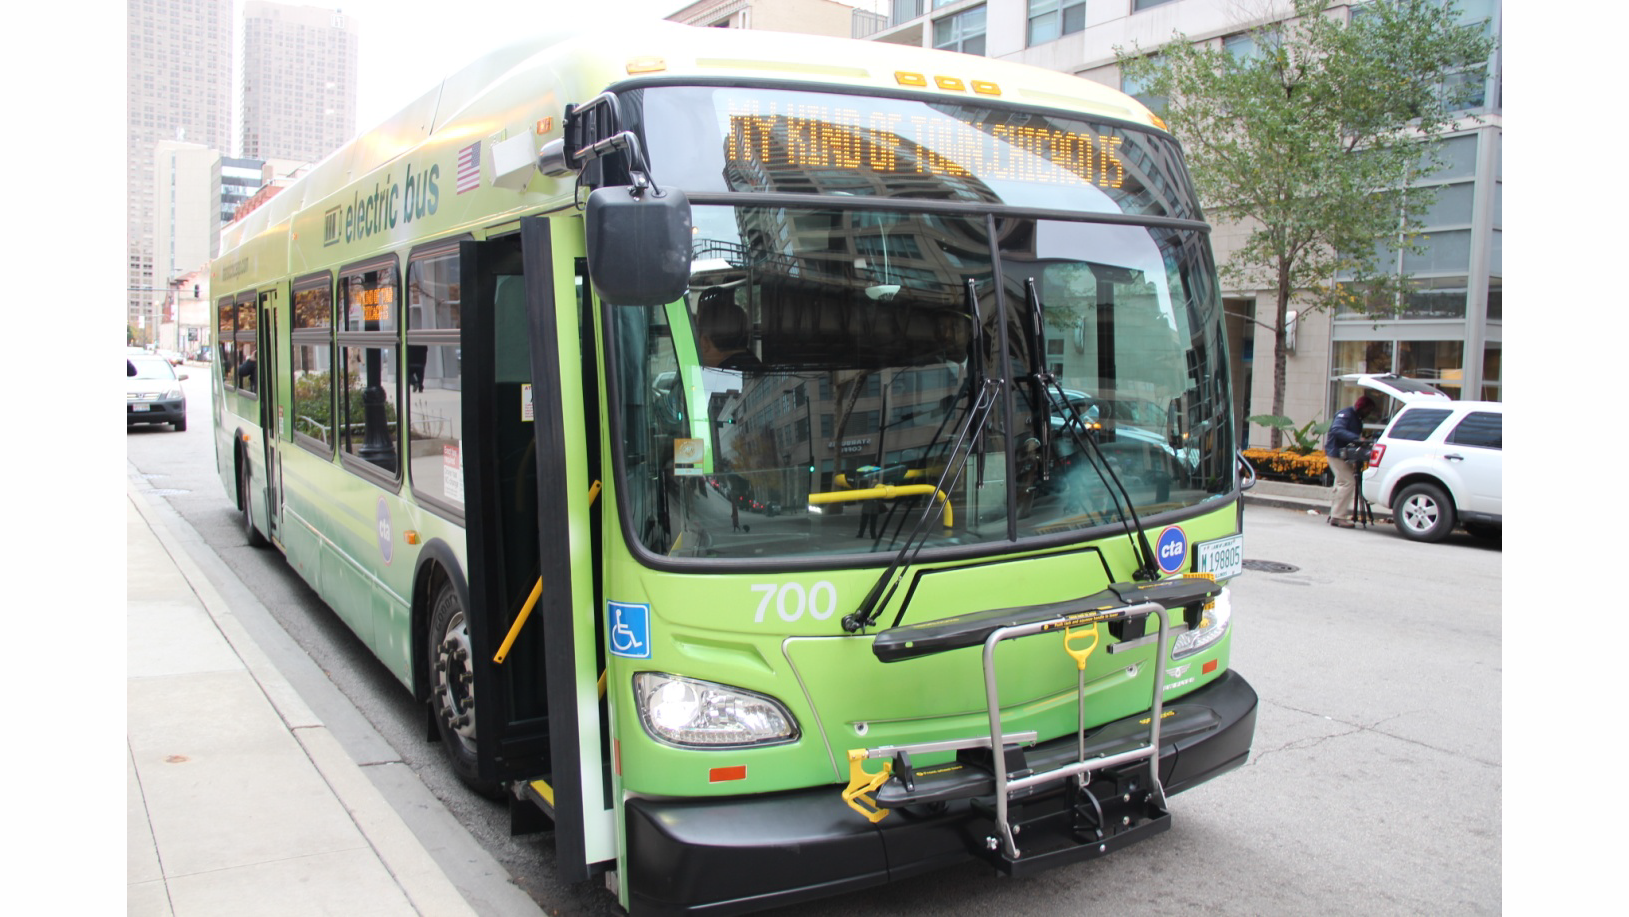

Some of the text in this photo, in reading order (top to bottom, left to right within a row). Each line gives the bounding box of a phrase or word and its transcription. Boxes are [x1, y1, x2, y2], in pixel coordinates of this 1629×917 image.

[729, 101, 777, 162] MY
[787, 103, 861, 168] KIND
[869, 112, 902, 171] OF
[1099, 135, 1123, 188] IS
[345, 163, 439, 244] electric bus
[379, 518, 391, 541] cta
[1161, 540, 1183, 558] cta
[1209, 545, 1240, 572] 198805
[751, 580, 837, 622] 700
